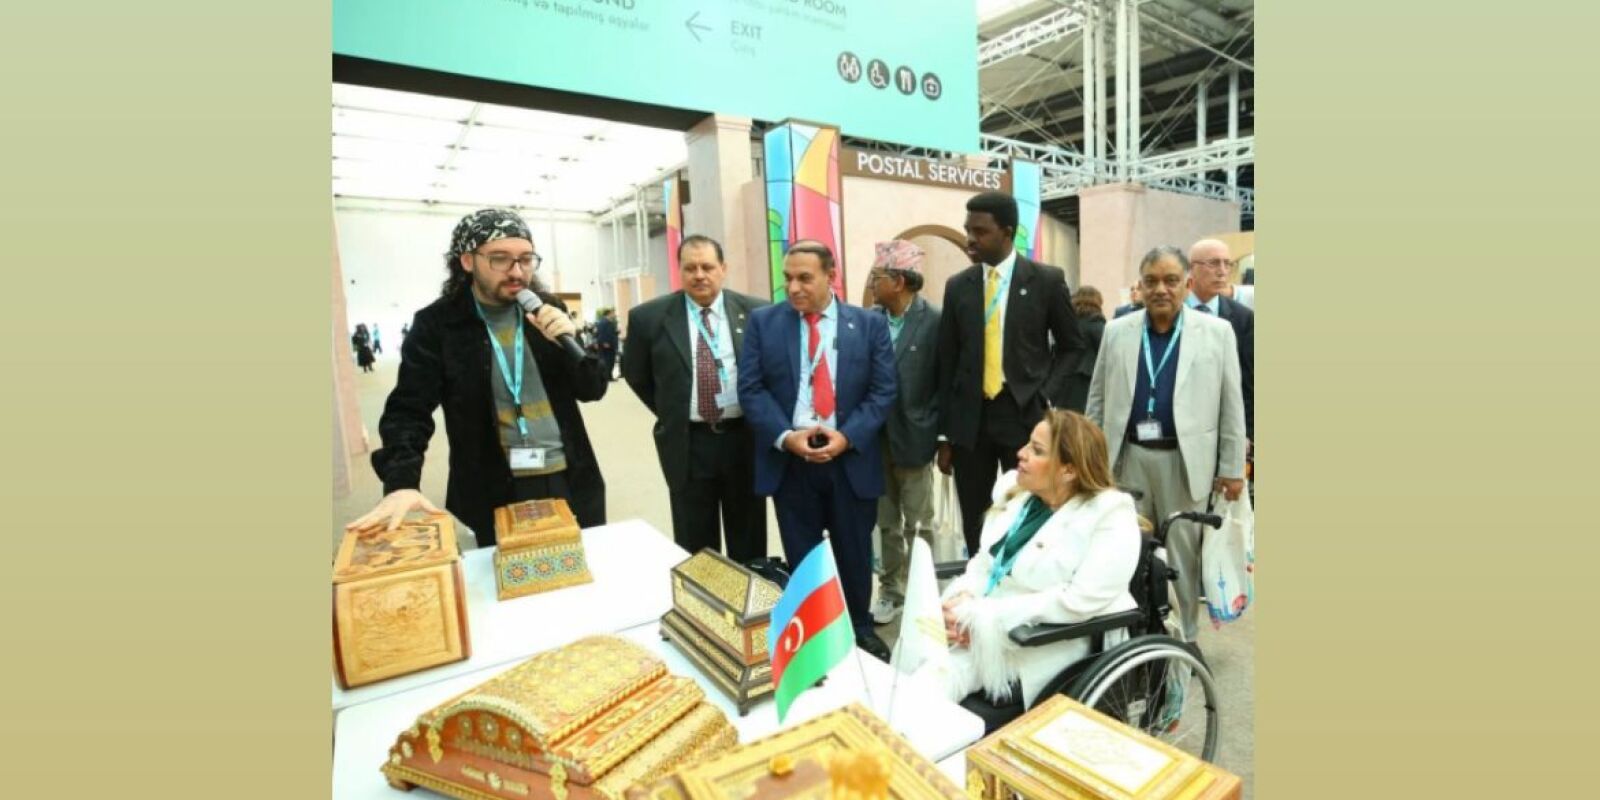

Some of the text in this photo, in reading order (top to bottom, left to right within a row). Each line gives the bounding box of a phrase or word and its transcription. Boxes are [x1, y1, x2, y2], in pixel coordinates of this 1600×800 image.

[804, 0, 847, 19] ROOM
[731, 20, 762, 40] EXIT
[857, 152, 1001, 190] POSTAL SERVICES
